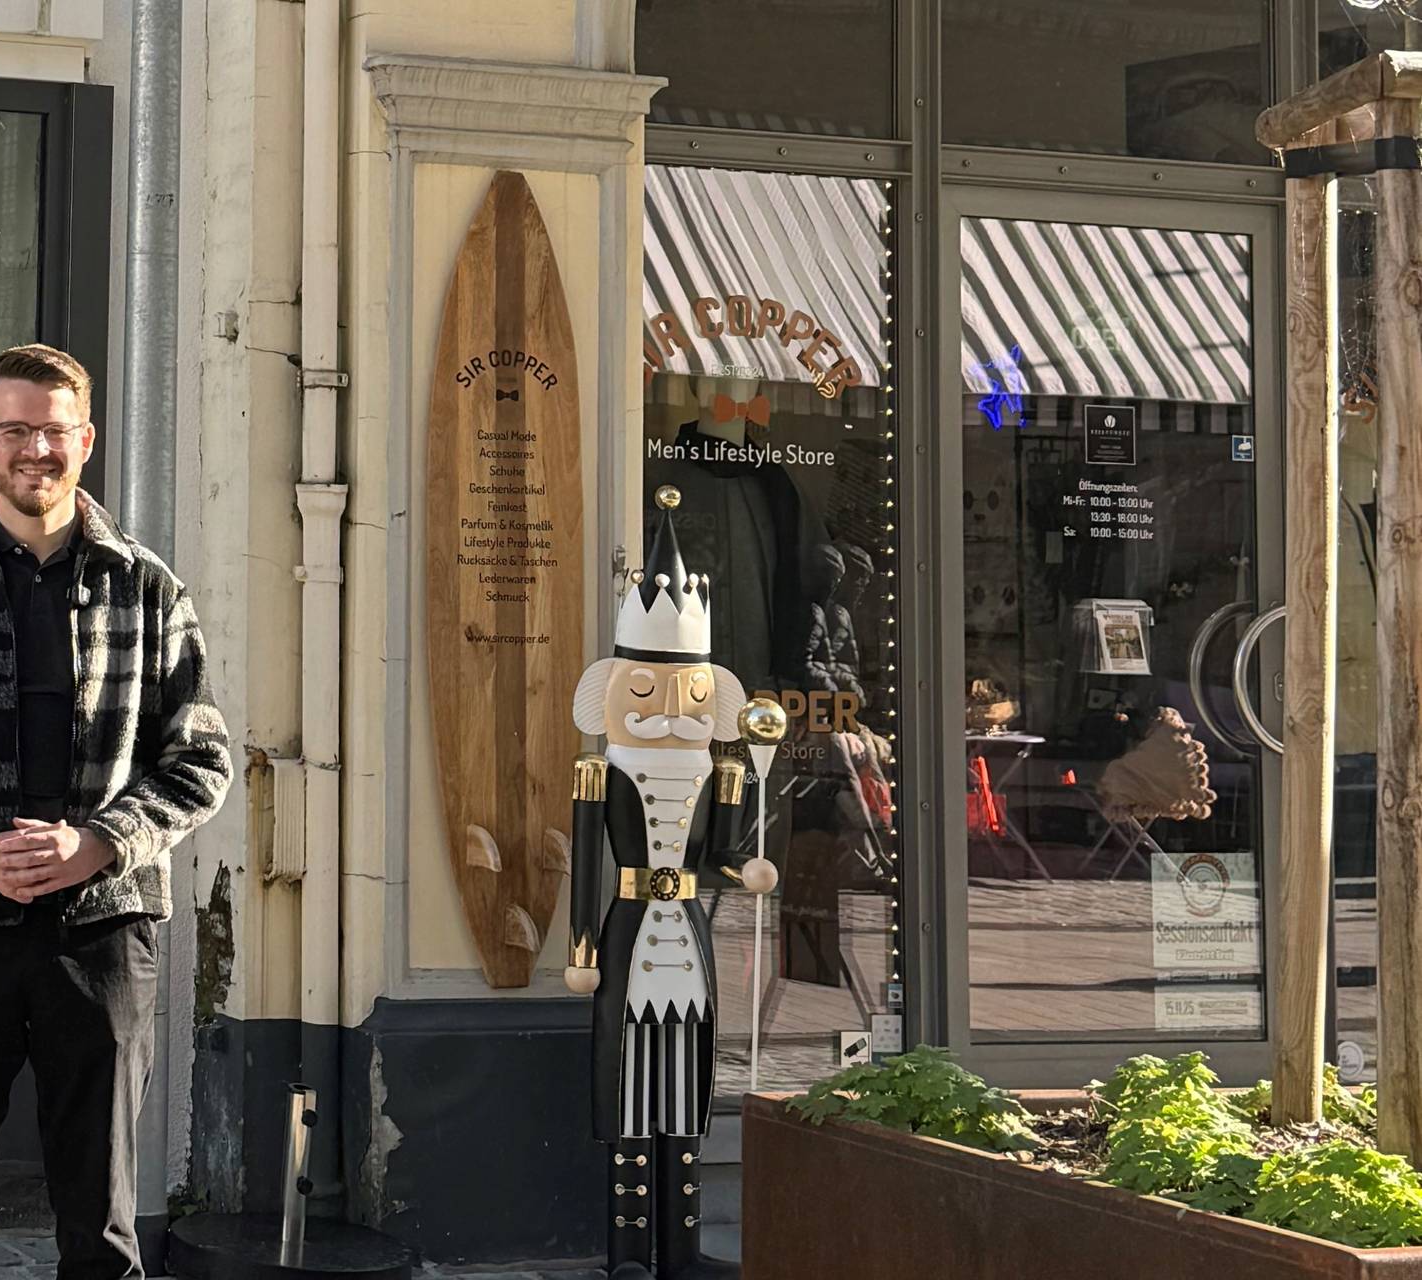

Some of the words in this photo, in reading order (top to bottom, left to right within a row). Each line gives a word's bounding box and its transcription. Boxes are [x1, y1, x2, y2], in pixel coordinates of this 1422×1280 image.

[695, 295, 863, 399] COPPER
[456, 357, 485, 389] SIR
[488, 350, 558, 392] COPPER
[477, 429, 509, 440] Casual
[511, 430, 536, 441] Mode
[479, 447, 535, 459] Accessoires
[647, 438, 699, 461] Men's
[704, 441, 782, 468] Lifestyle
[786, 444, 835, 465] Store
[489, 465, 525, 476] Schuhe
[469, 483, 545, 495] Geschenkartikel
[1078, 478, 1138, 494] Öffnungszeiten:
[487, 500, 527, 512] Feinkost
[1090, 496, 1111, 507] 10:00
[1118, 497, 1138, 508] 13:00
[1139, 498, 1154, 509] Uhr
[461, 518, 497, 529] Parfum
[499, 519, 506, 530] &
[509, 519, 554, 531] Kosmetik
[1090, 512, 1111, 522] 13:30
[1118, 513, 1138, 523] 18:00
[1139, 514, 1154, 524] Uhr
[1090, 527, 1111, 538] 10:00
[1118, 528, 1138, 539] 15:00
[1139, 529, 1154, 540] Uhr
[464, 536, 505, 550] Lifestyle
[507, 537, 551, 549] Produkte
[457, 554, 507, 566] Rucksäcke
[509, 555, 517, 566] &
[518, 556, 558, 567] Taschen
[479, 572, 536, 584] Lederwaren
[485, 590, 530, 602] Schmuck
[465, 632, 550, 646] www.sircopper.de
[781, 741, 826, 760] Store
[1155, 921, 1254, 943] Sessionsauftakt
